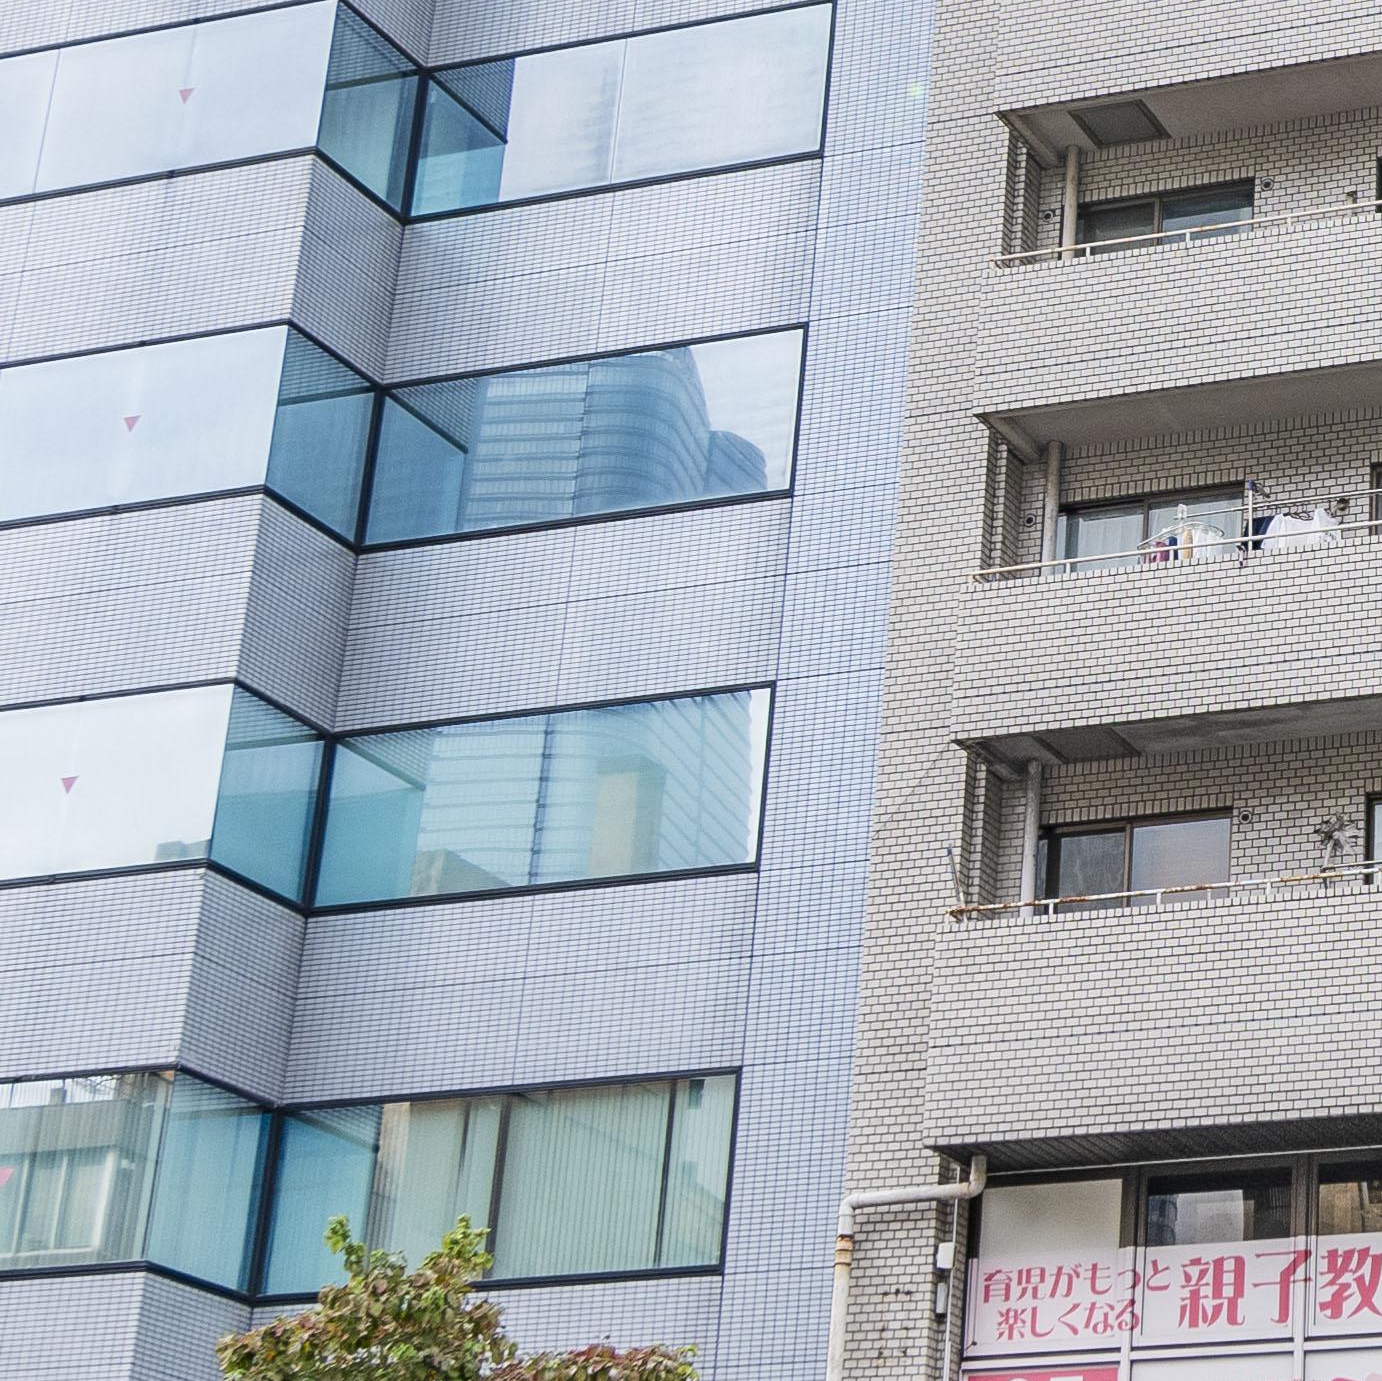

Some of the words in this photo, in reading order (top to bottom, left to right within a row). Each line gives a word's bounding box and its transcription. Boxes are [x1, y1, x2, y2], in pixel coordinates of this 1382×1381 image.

[982, 1260, 1171, 1305] 育児がもっと
[996, 1298, 1140, 1341] 楽しくなる
